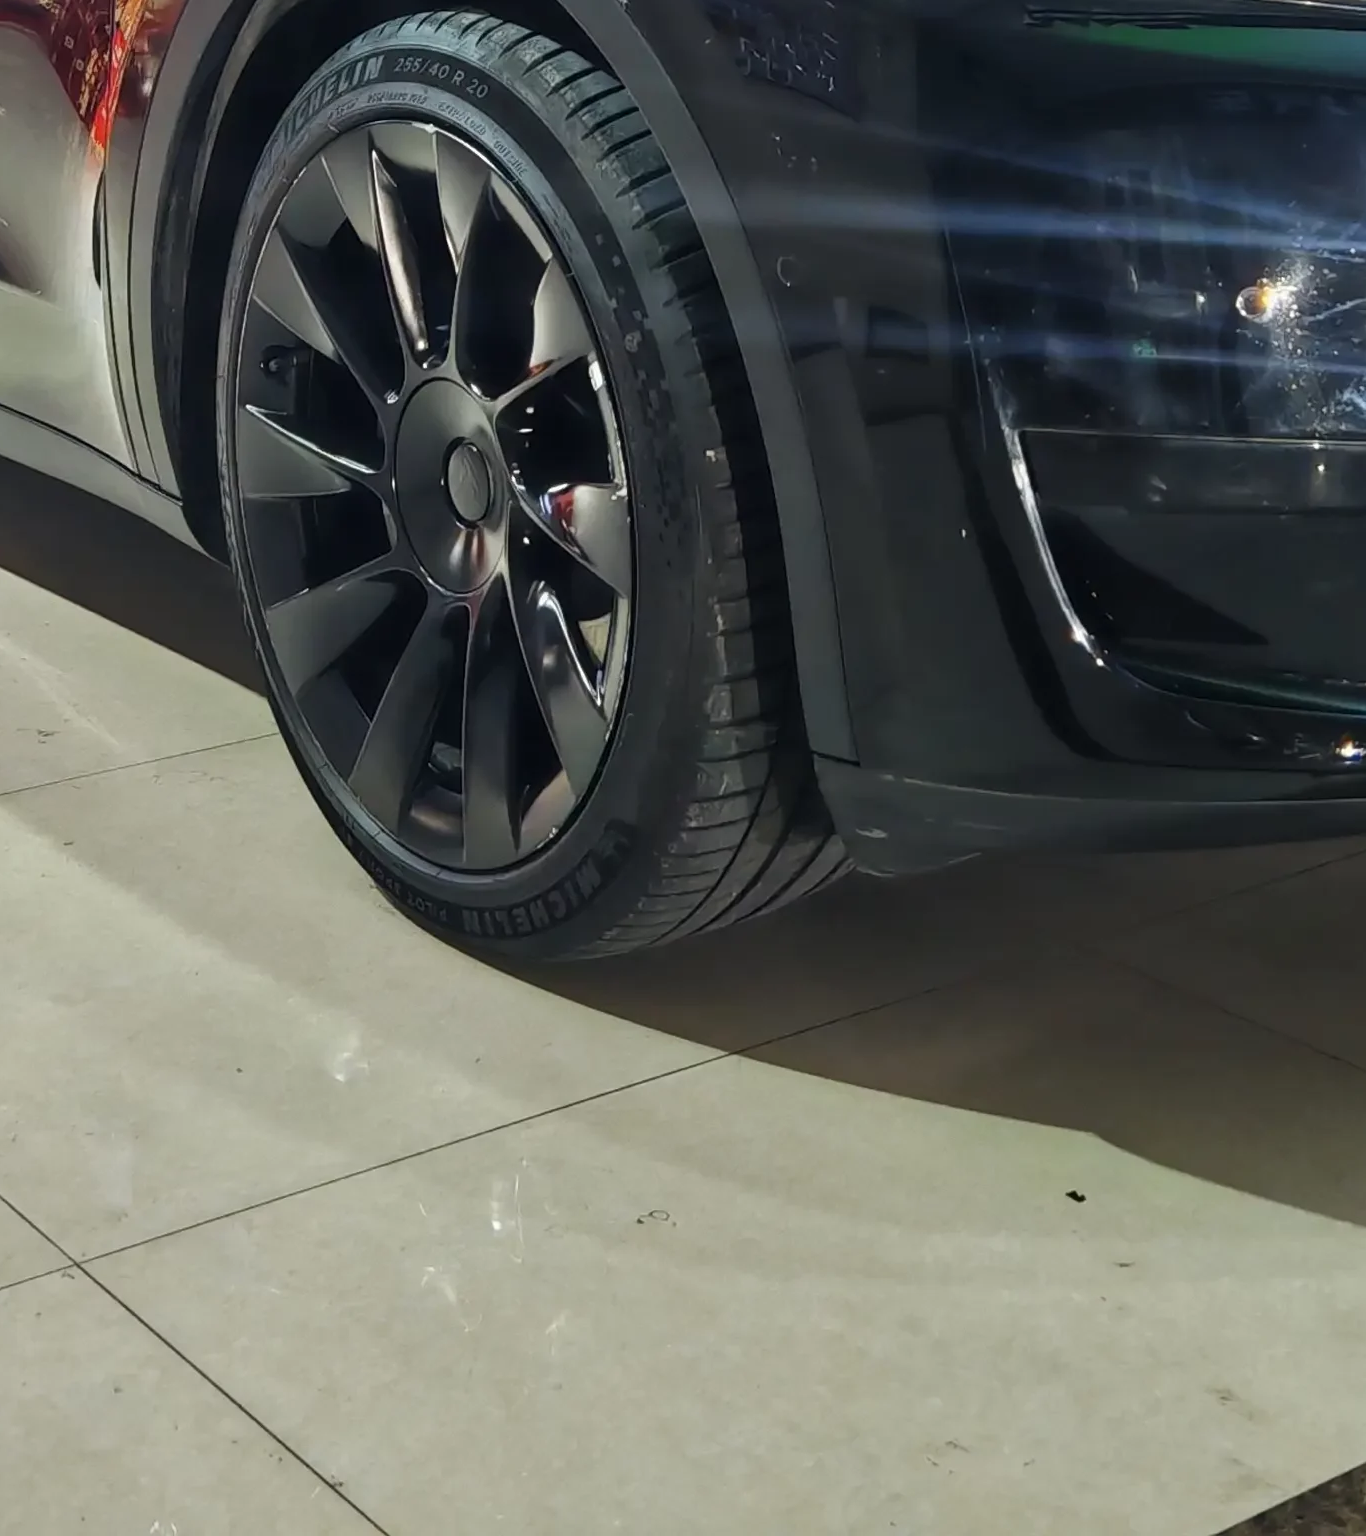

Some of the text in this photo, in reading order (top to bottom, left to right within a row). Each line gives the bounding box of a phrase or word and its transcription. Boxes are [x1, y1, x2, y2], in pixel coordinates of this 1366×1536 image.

[393, 55, 450, 80] 255/40
[453, 68, 463, 84] R
[466, 76, 490, 99] 20
[462, 859, 602, 937] MICHELIN
